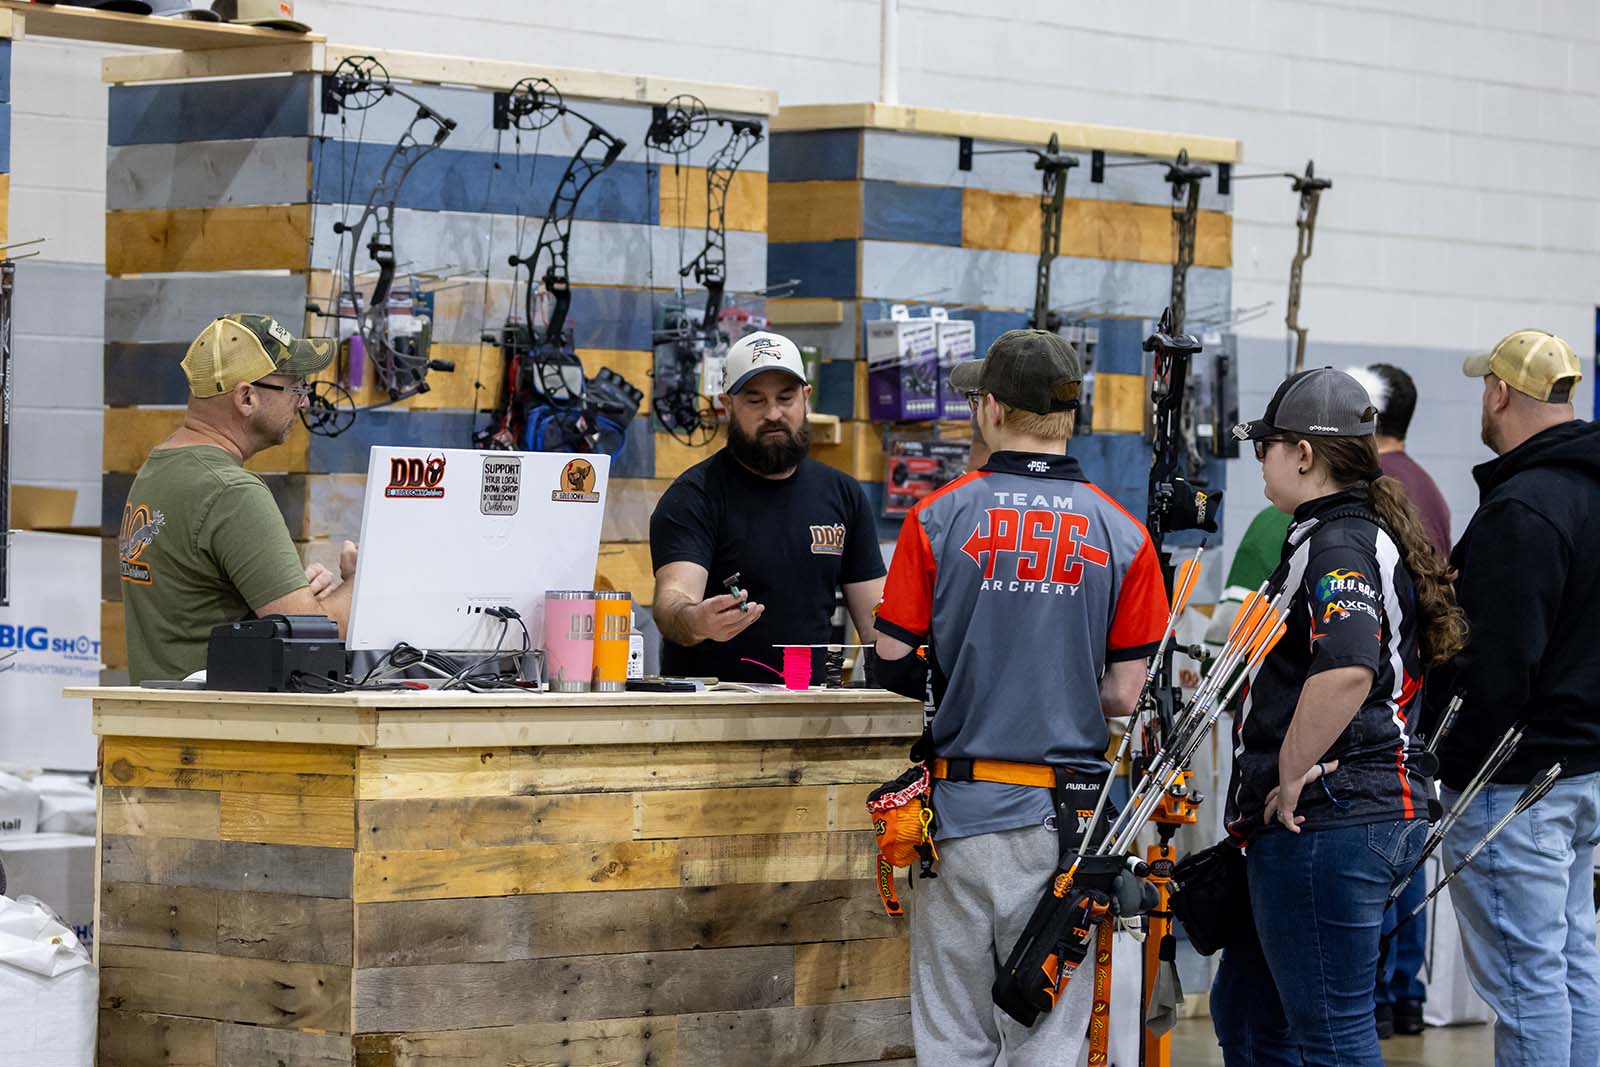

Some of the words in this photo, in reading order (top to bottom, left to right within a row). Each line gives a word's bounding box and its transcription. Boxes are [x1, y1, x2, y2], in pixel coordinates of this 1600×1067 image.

[485, 463, 520, 474] SUPPORT
[485, 475, 501, 484] YOUR
[501, 476, 518, 484] LOCAL
[484, 485, 500, 493] BOW
[501, 485, 519, 493] SHOP
[994, 492, 1073, 510] TEAM
[983, 508, 1091, 585] PSE
[980, 580, 1080, 596] ARCHERY
[0, 624, 49, 650] BIG
[52, 635, 100, 654] SHOT
[1065, 783, 1100, 791] AVALON
